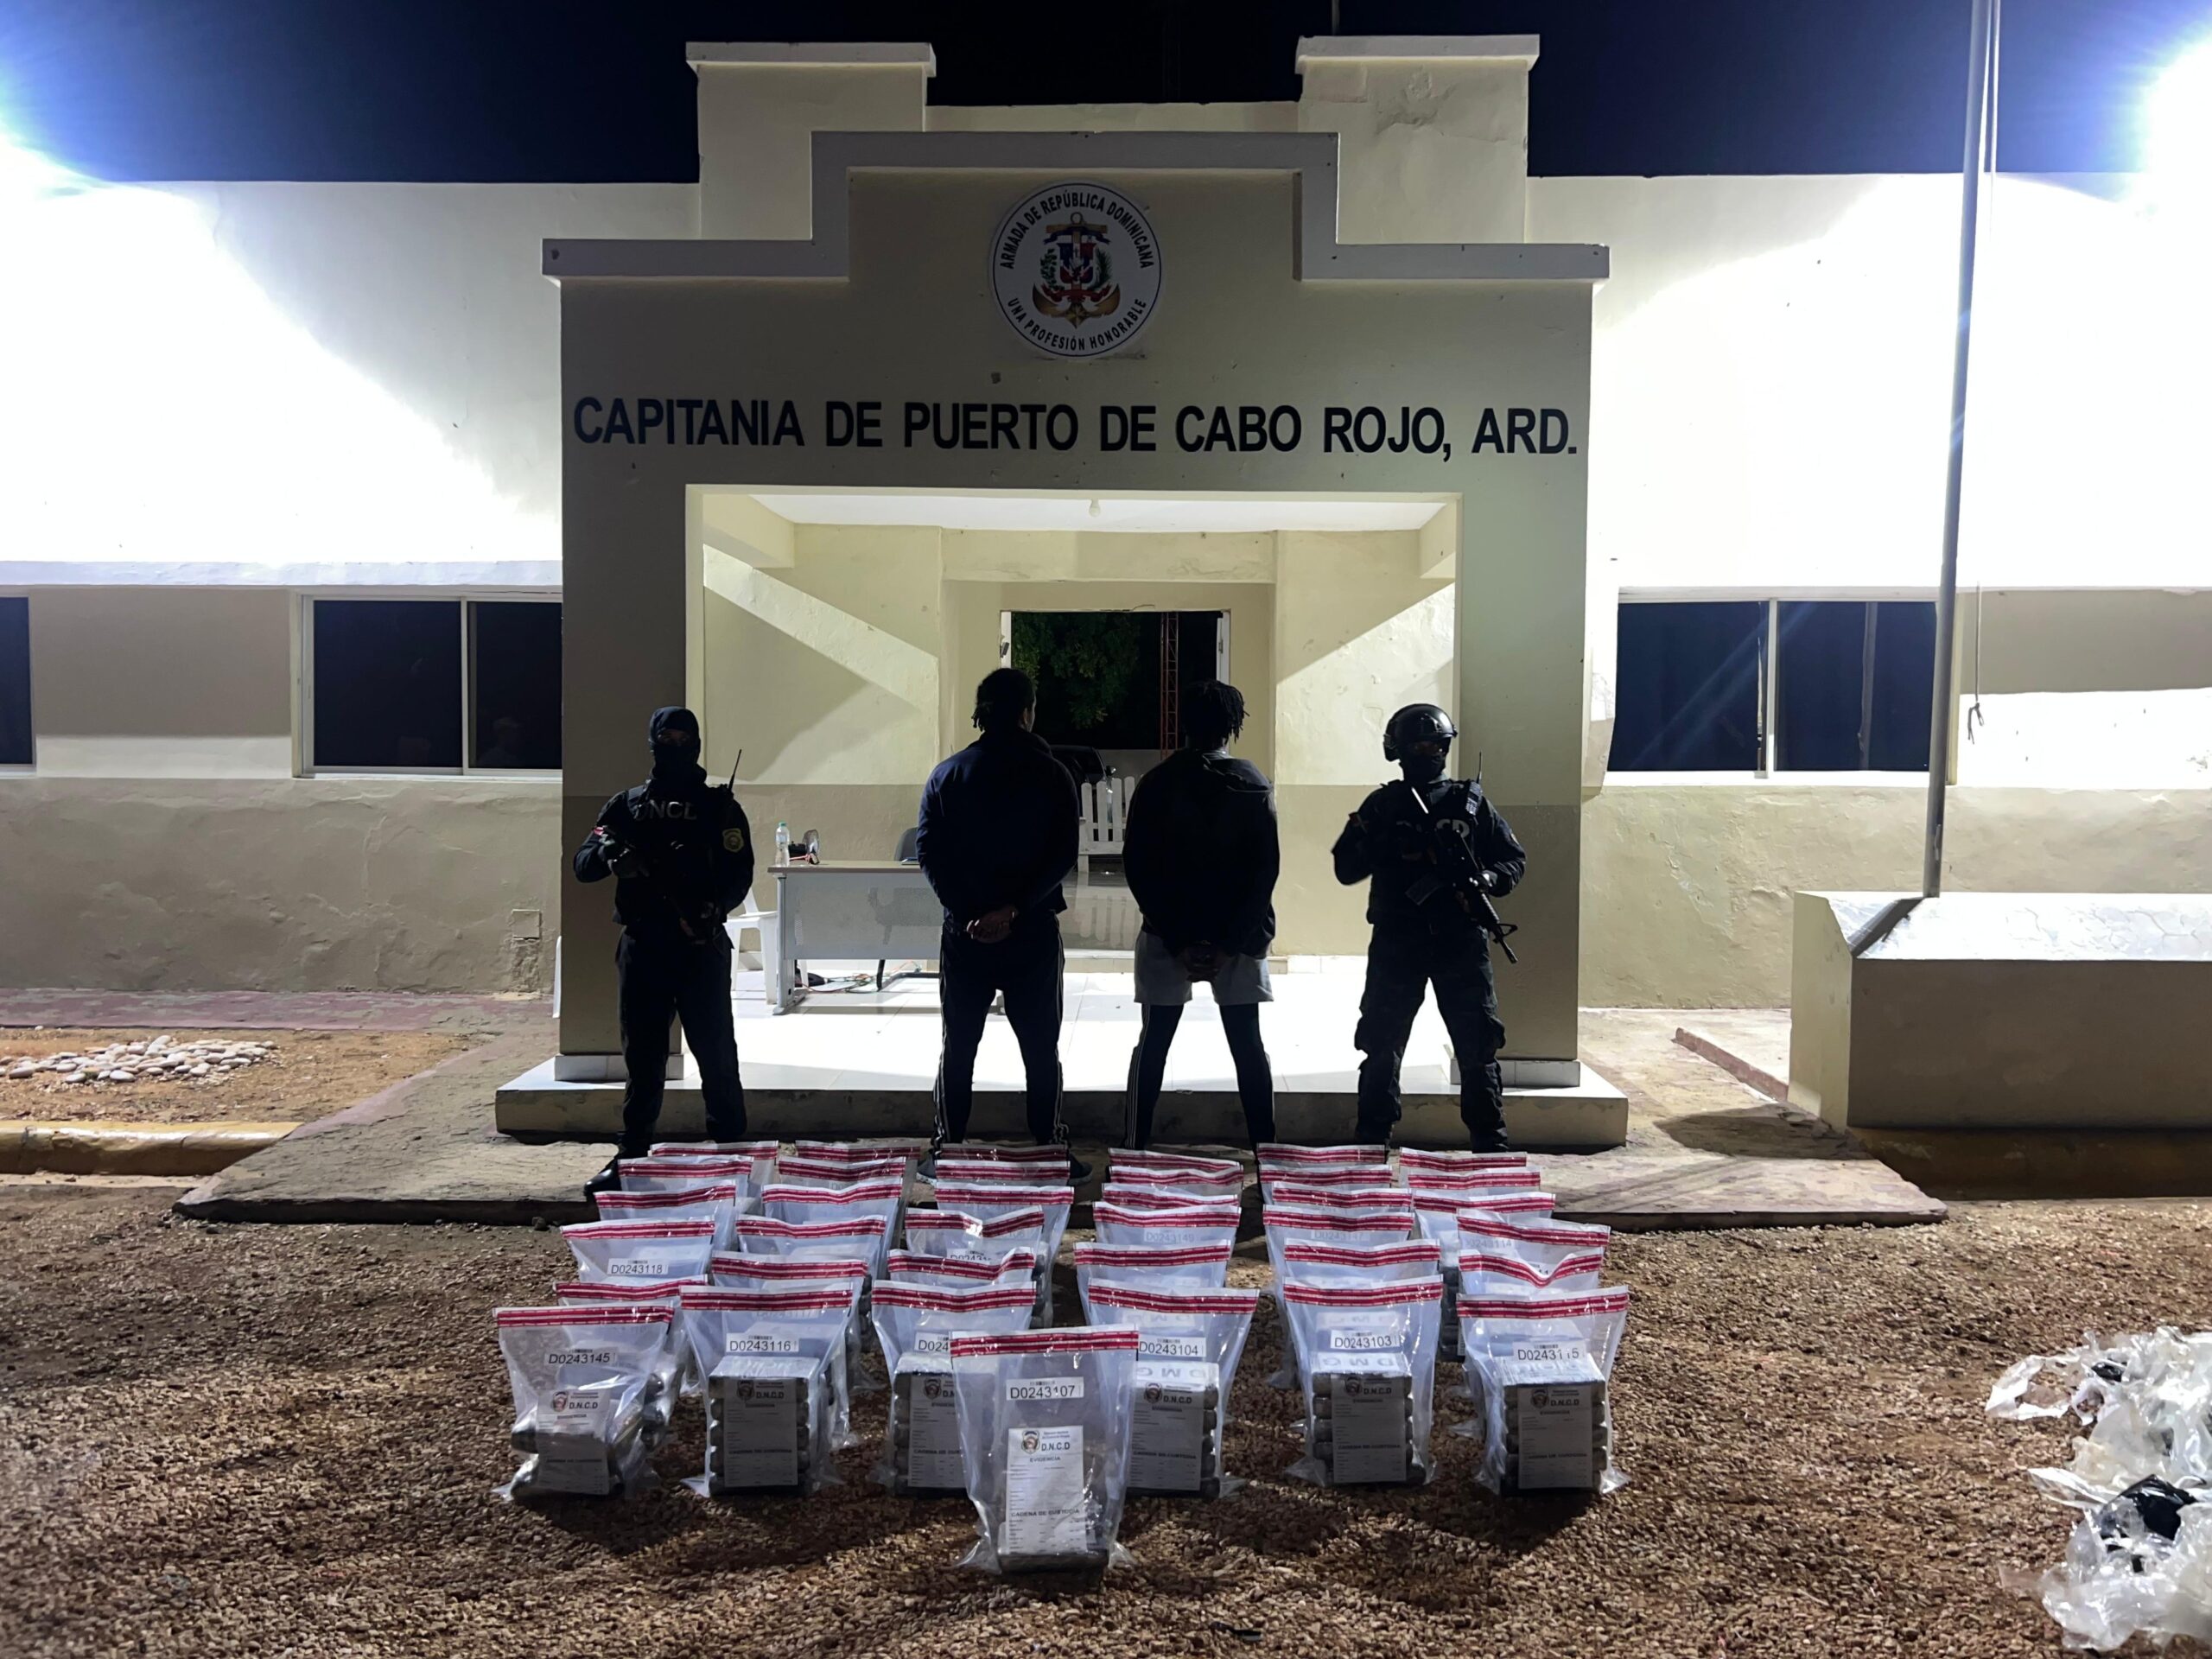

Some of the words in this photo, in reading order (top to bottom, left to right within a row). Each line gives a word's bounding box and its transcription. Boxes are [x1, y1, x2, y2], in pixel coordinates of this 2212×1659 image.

[1000, 221, 1028, 270] ARMADA
[1024, 206, 1042, 225] DE
[1039, 189, 1105, 214] REPÚBLICA
[1106, 201, 1154, 269] DOMINICANA
[1007, 297, 1027, 323] UNA
[1024, 320, 1085, 351] PROFESIÓN
[1090, 299, 1147, 349] HONORABLE
[573, 396, 805, 447] CAPITANIA
[825, 401, 883, 448] DE
[903, 402, 1079, 451] PUERTO
[1100, 406, 1157, 452] DE
[1176, 404, 1302, 453] CABO
[1323, 406, 1452, 462] ROJO,
[1471, 408, 1578, 455] ARD.
[611, 1264, 663, 1274] D0243118
[729, 1339, 791, 1352] D0243116
[918, 1339, 950, 1352] D024
[1139, 1341, 1198, 1356] D0243104
[1334, 1335, 1392, 1349] D0243103
[548, 1352, 610, 1364] D0243145
[1009, 1385, 1076, 1399] D0243107
[569, 1401, 599, 1410] D.N.C.D
[1163, 1395, 1192, 1404] D.N.C.D
[1041, 1441, 1071, 1452] D.N.C.D
